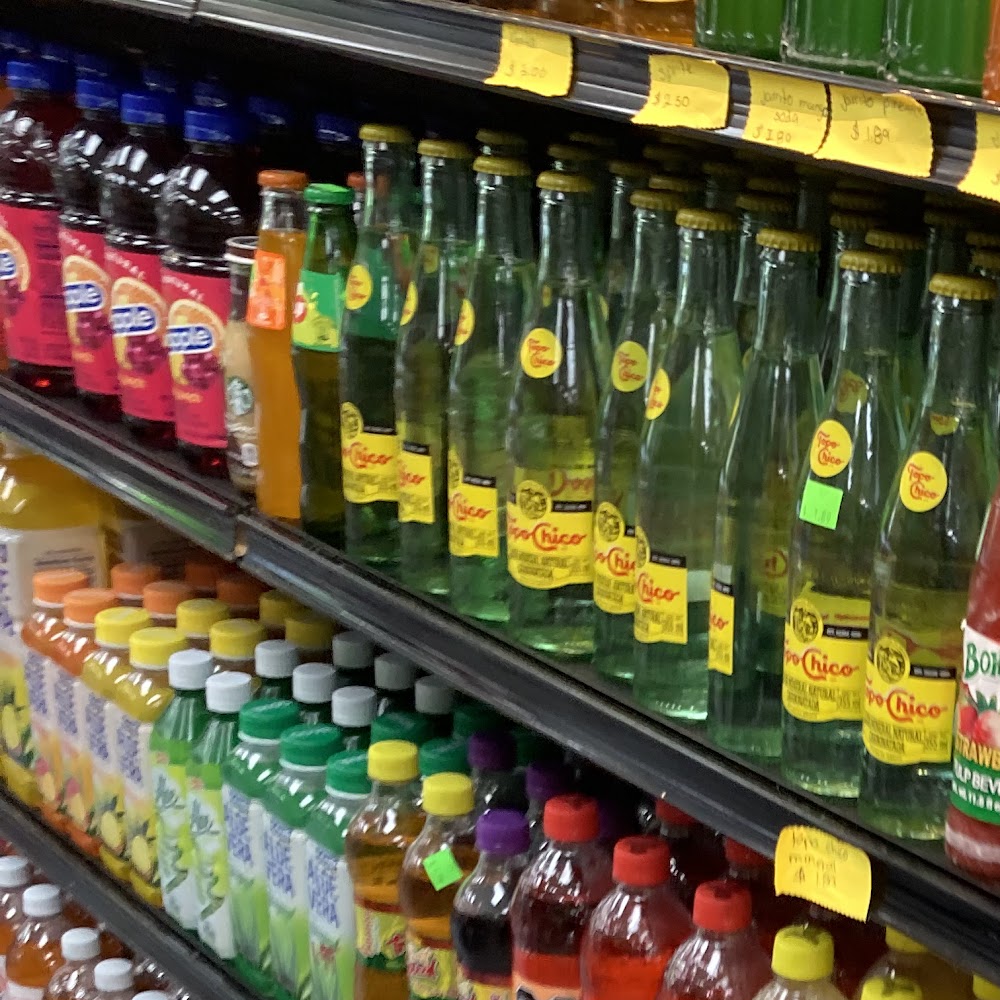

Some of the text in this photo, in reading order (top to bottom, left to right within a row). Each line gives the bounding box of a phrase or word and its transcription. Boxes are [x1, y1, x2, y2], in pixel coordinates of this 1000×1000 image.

[817, 430, 840, 449] Topo
[818, 447, 844, 466] Chico
[907, 462, 935, 483] Topo
[909, 481, 940, 501] Chico
[532, 521, 587, 551] Chico
[637, 572, 681, 604] Chico
[802, 646, 860, 681] Chico
[886, 688, 944, 722] Chico
